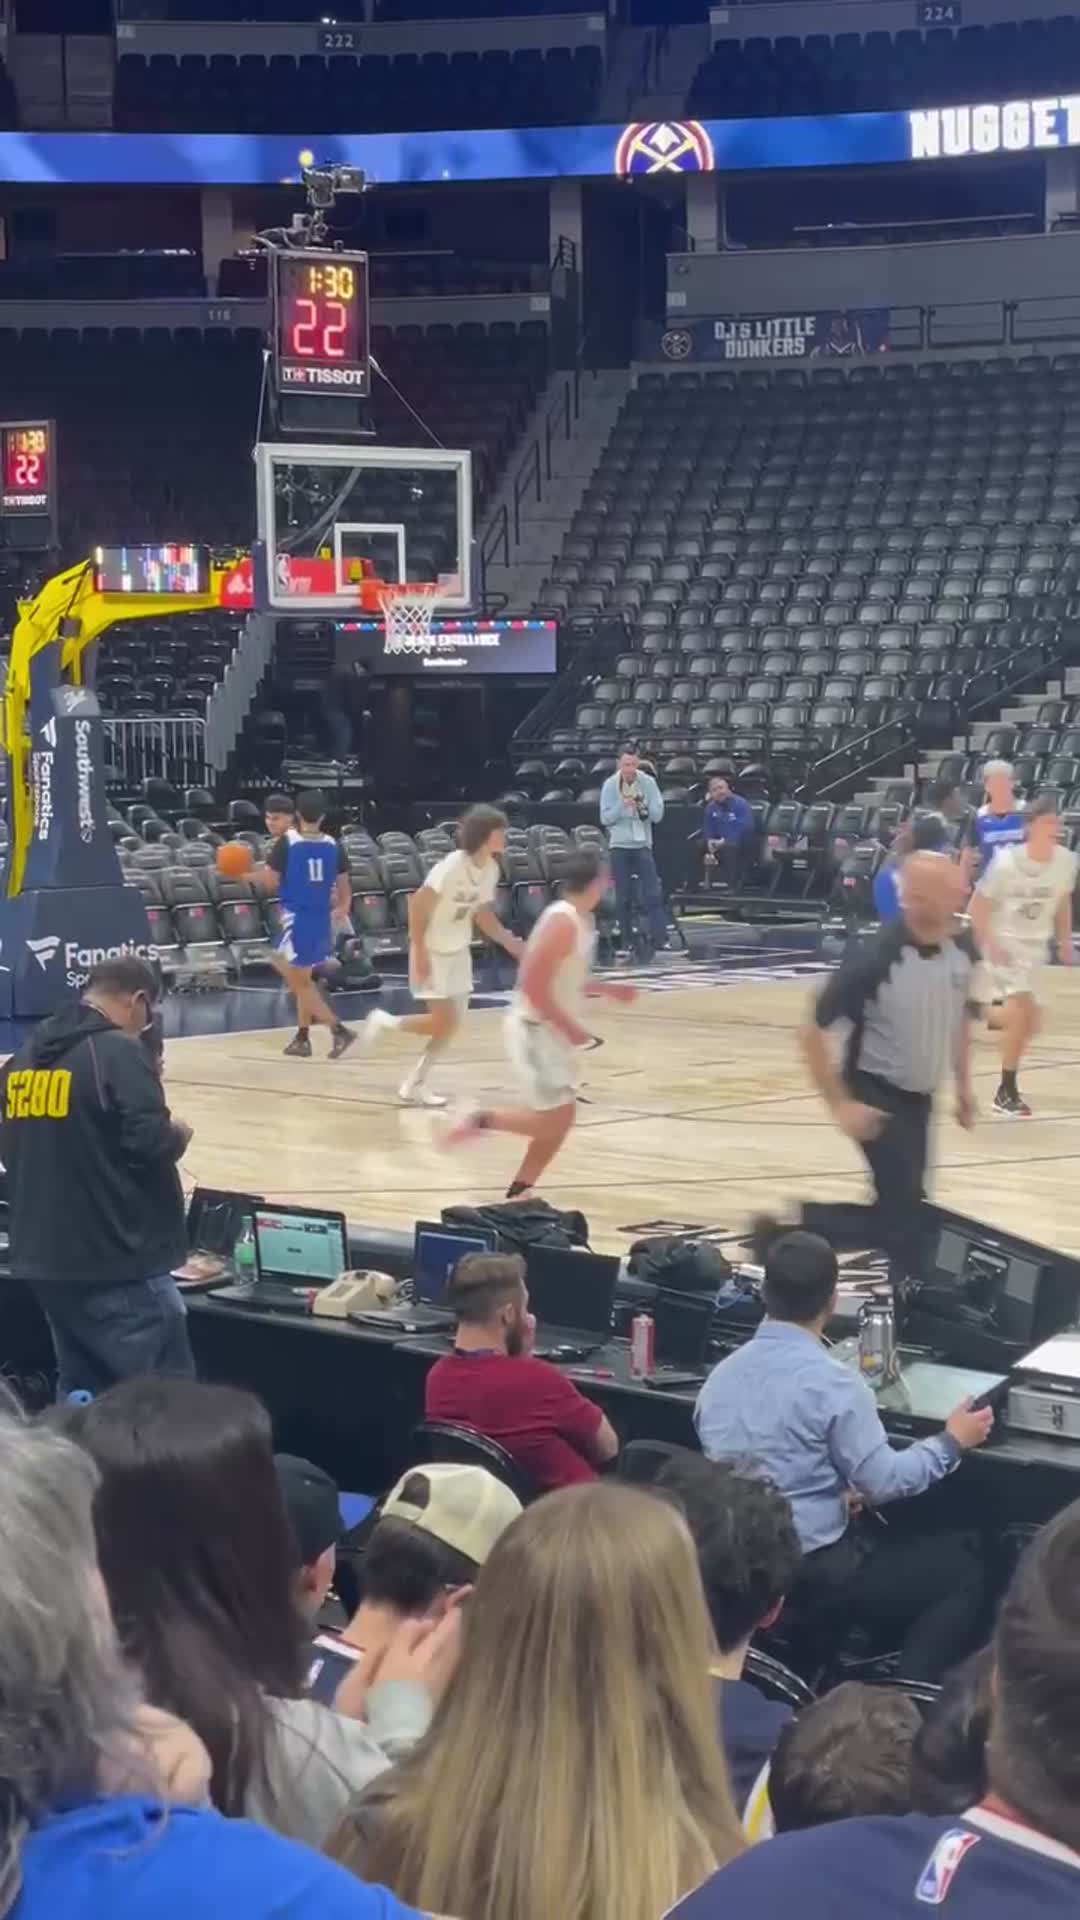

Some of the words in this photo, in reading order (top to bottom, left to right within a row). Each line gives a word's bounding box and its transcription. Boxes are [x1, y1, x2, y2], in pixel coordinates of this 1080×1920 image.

[924, 7, 954, 21] 224
[324, 33, 354, 48] 222
[310, 265, 353, 299] 1:30
[293, 299, 347, 356] 22
[755, 316, 816, 339] LITTLE
[725, 337, 805, 359] DUNKERS
[306, 368, 365, 385] TISSOT
[16, 454, 40, 484] 22
[74, 719, 95, 830] Southwest
[38, 751, 54, 841] Fanatics
[308, 857, 324, 882] 11
[6, 1069, 72, 1119] 5280
